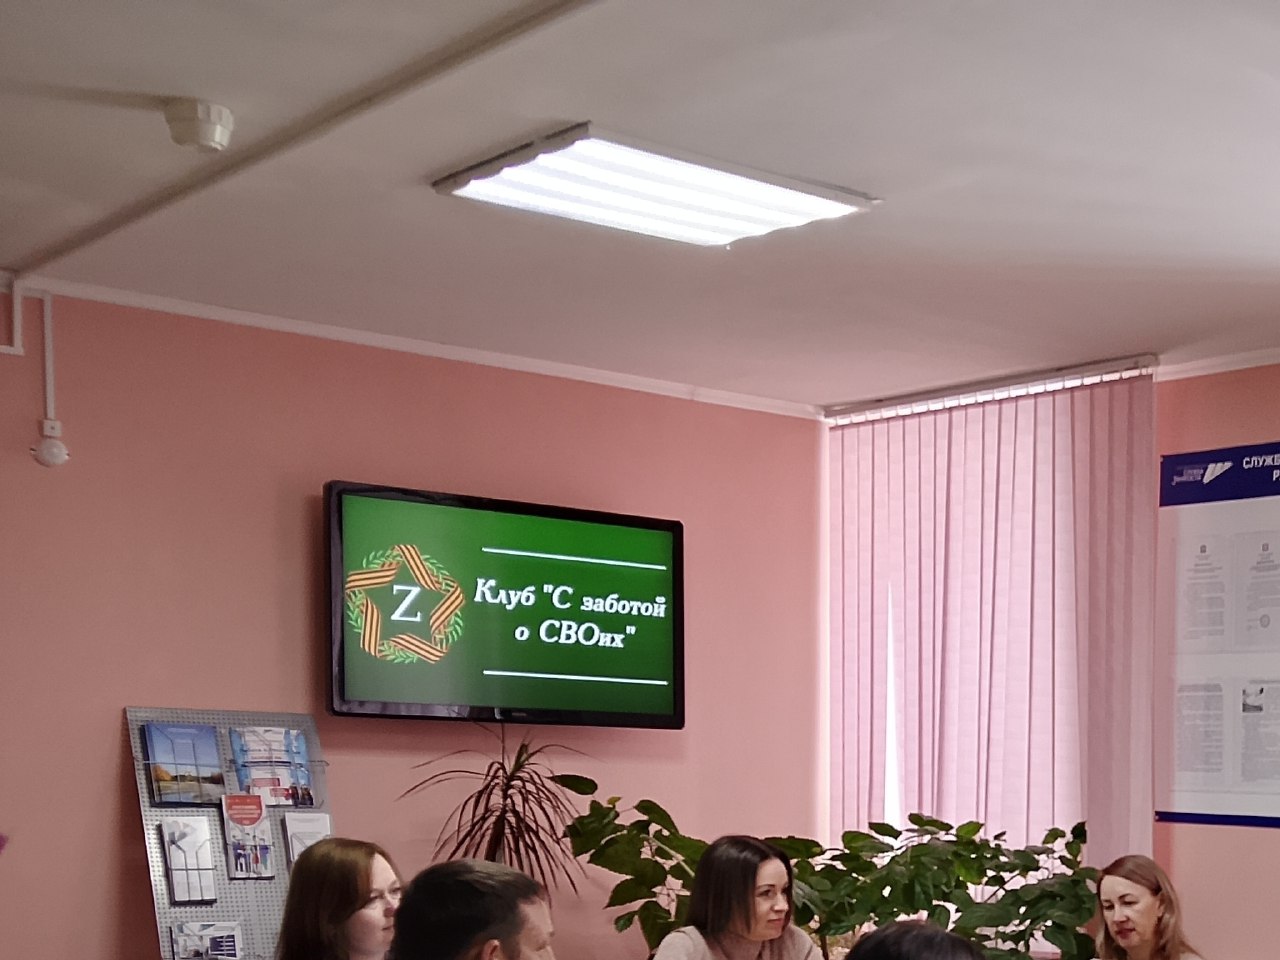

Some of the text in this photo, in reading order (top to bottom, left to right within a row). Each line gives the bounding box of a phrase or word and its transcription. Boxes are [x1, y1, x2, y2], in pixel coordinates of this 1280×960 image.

[390, 584, 423, 622] Z
[473, 577, 536, 611] Клуб
[580, 594, 668, 618] заботой
[515, 618, 637, 648] о СВОих"
